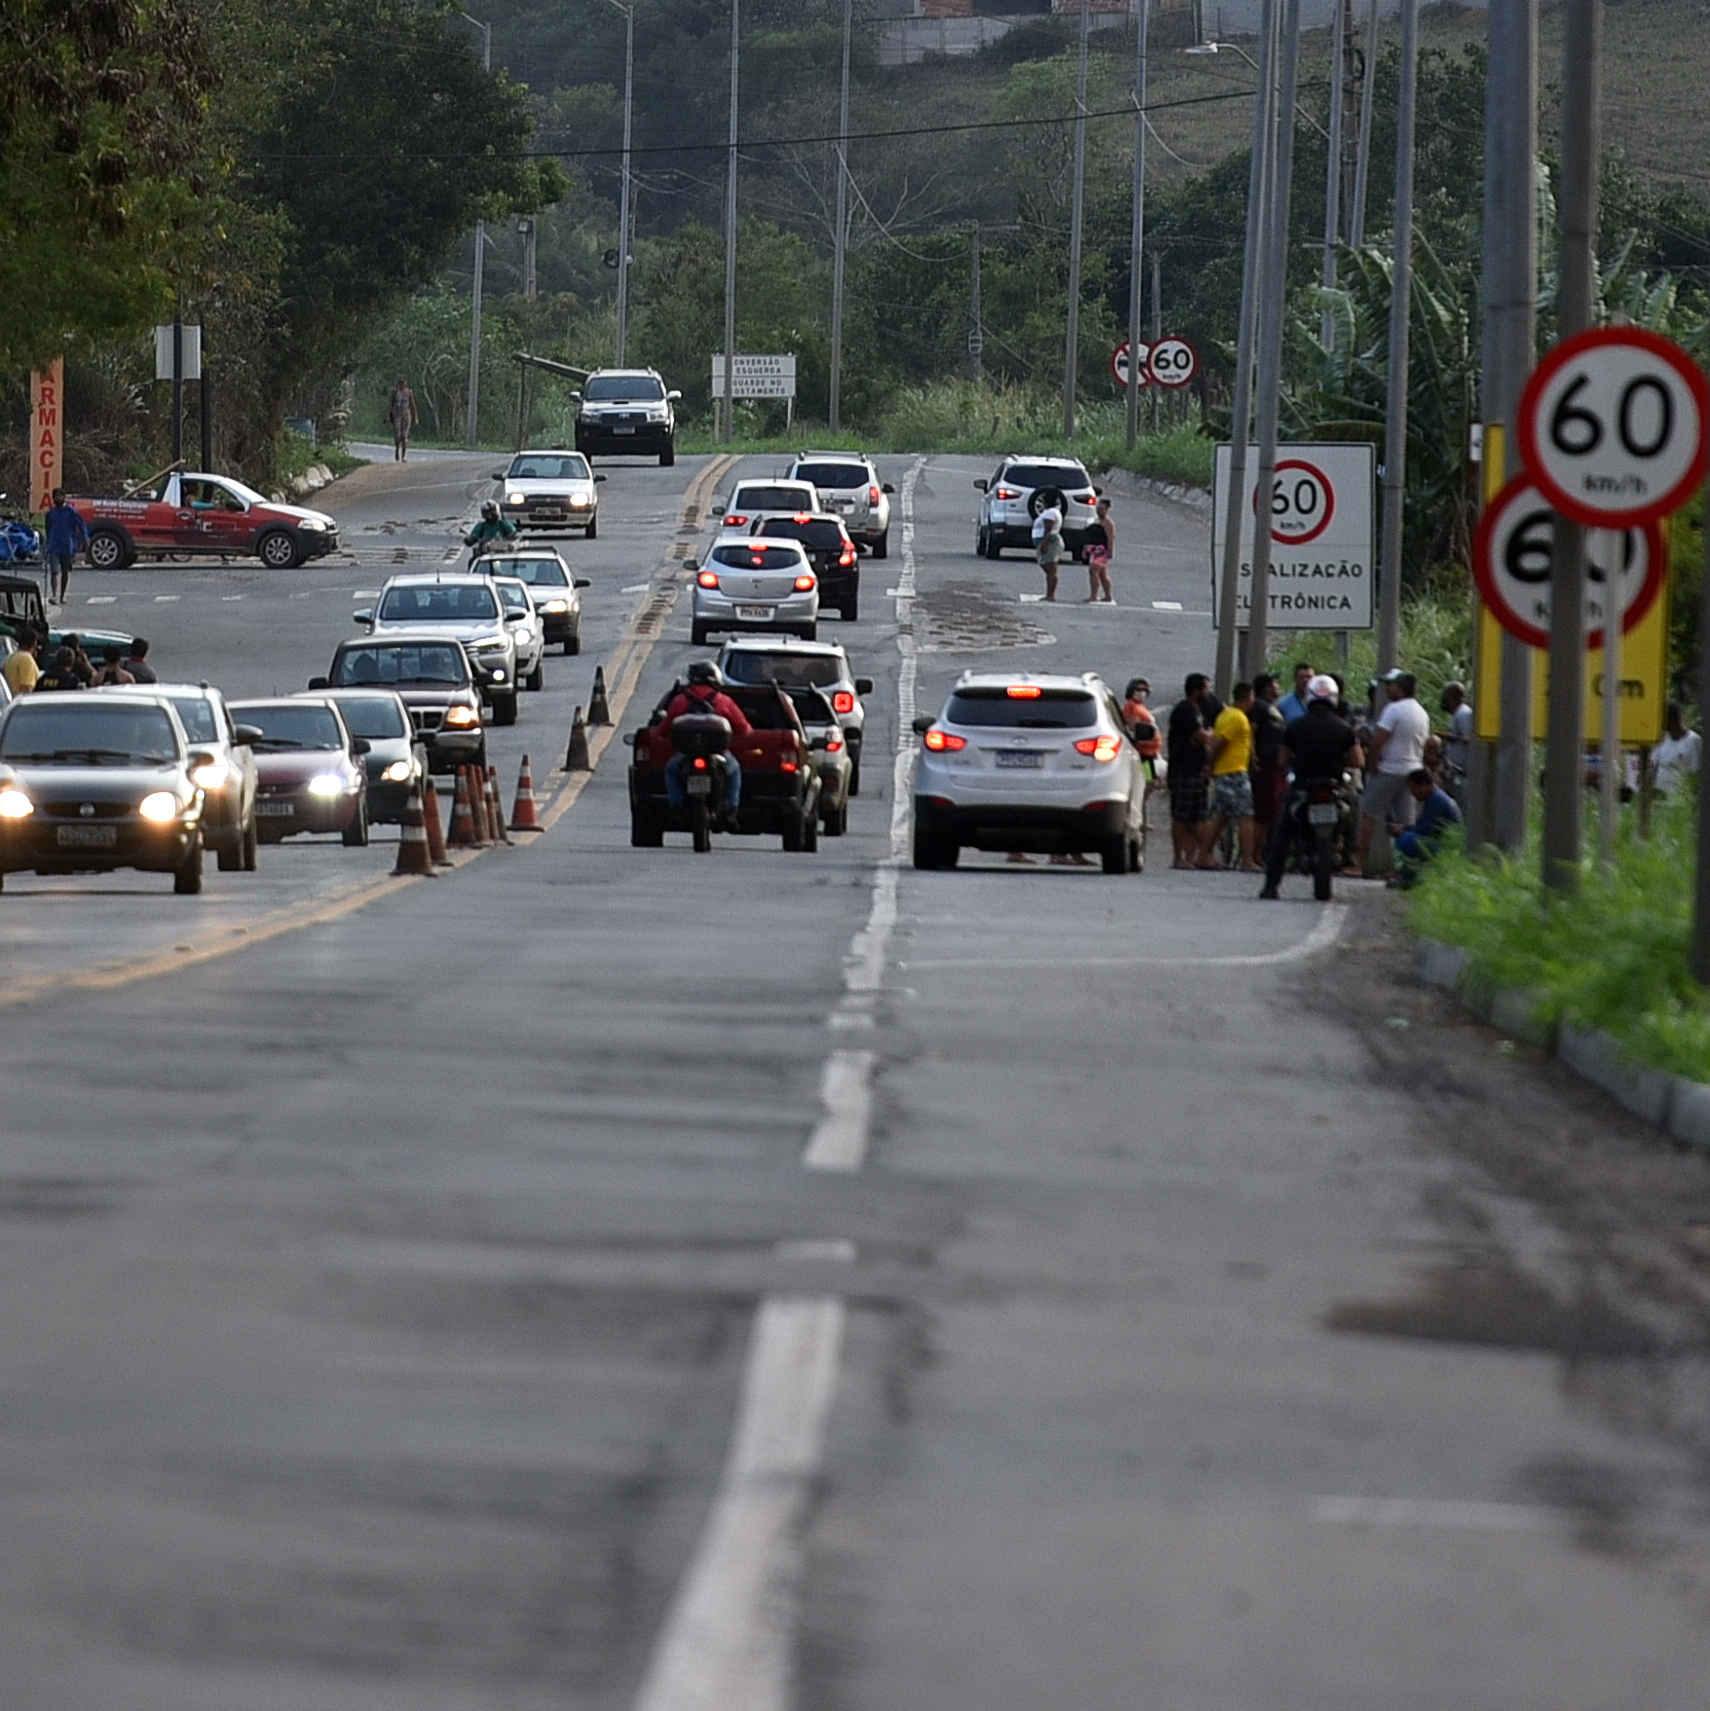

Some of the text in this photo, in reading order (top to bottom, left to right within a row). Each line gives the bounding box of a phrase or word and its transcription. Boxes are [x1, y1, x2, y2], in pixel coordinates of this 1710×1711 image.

[1154, 348, 1191, 370] 60
[732, 379, 765, 387] GUARDE
[1550, 372, 1676, 458] 60
[39, 371, 56, 511] ARMACIA
[1583, 473, 1648, 496] km/h
[1272, 478, 1317, 515] 60
[1280, 520, 1307, 530] km/h
[1240, 559, 1363, 578] SALIZAÇÃO
